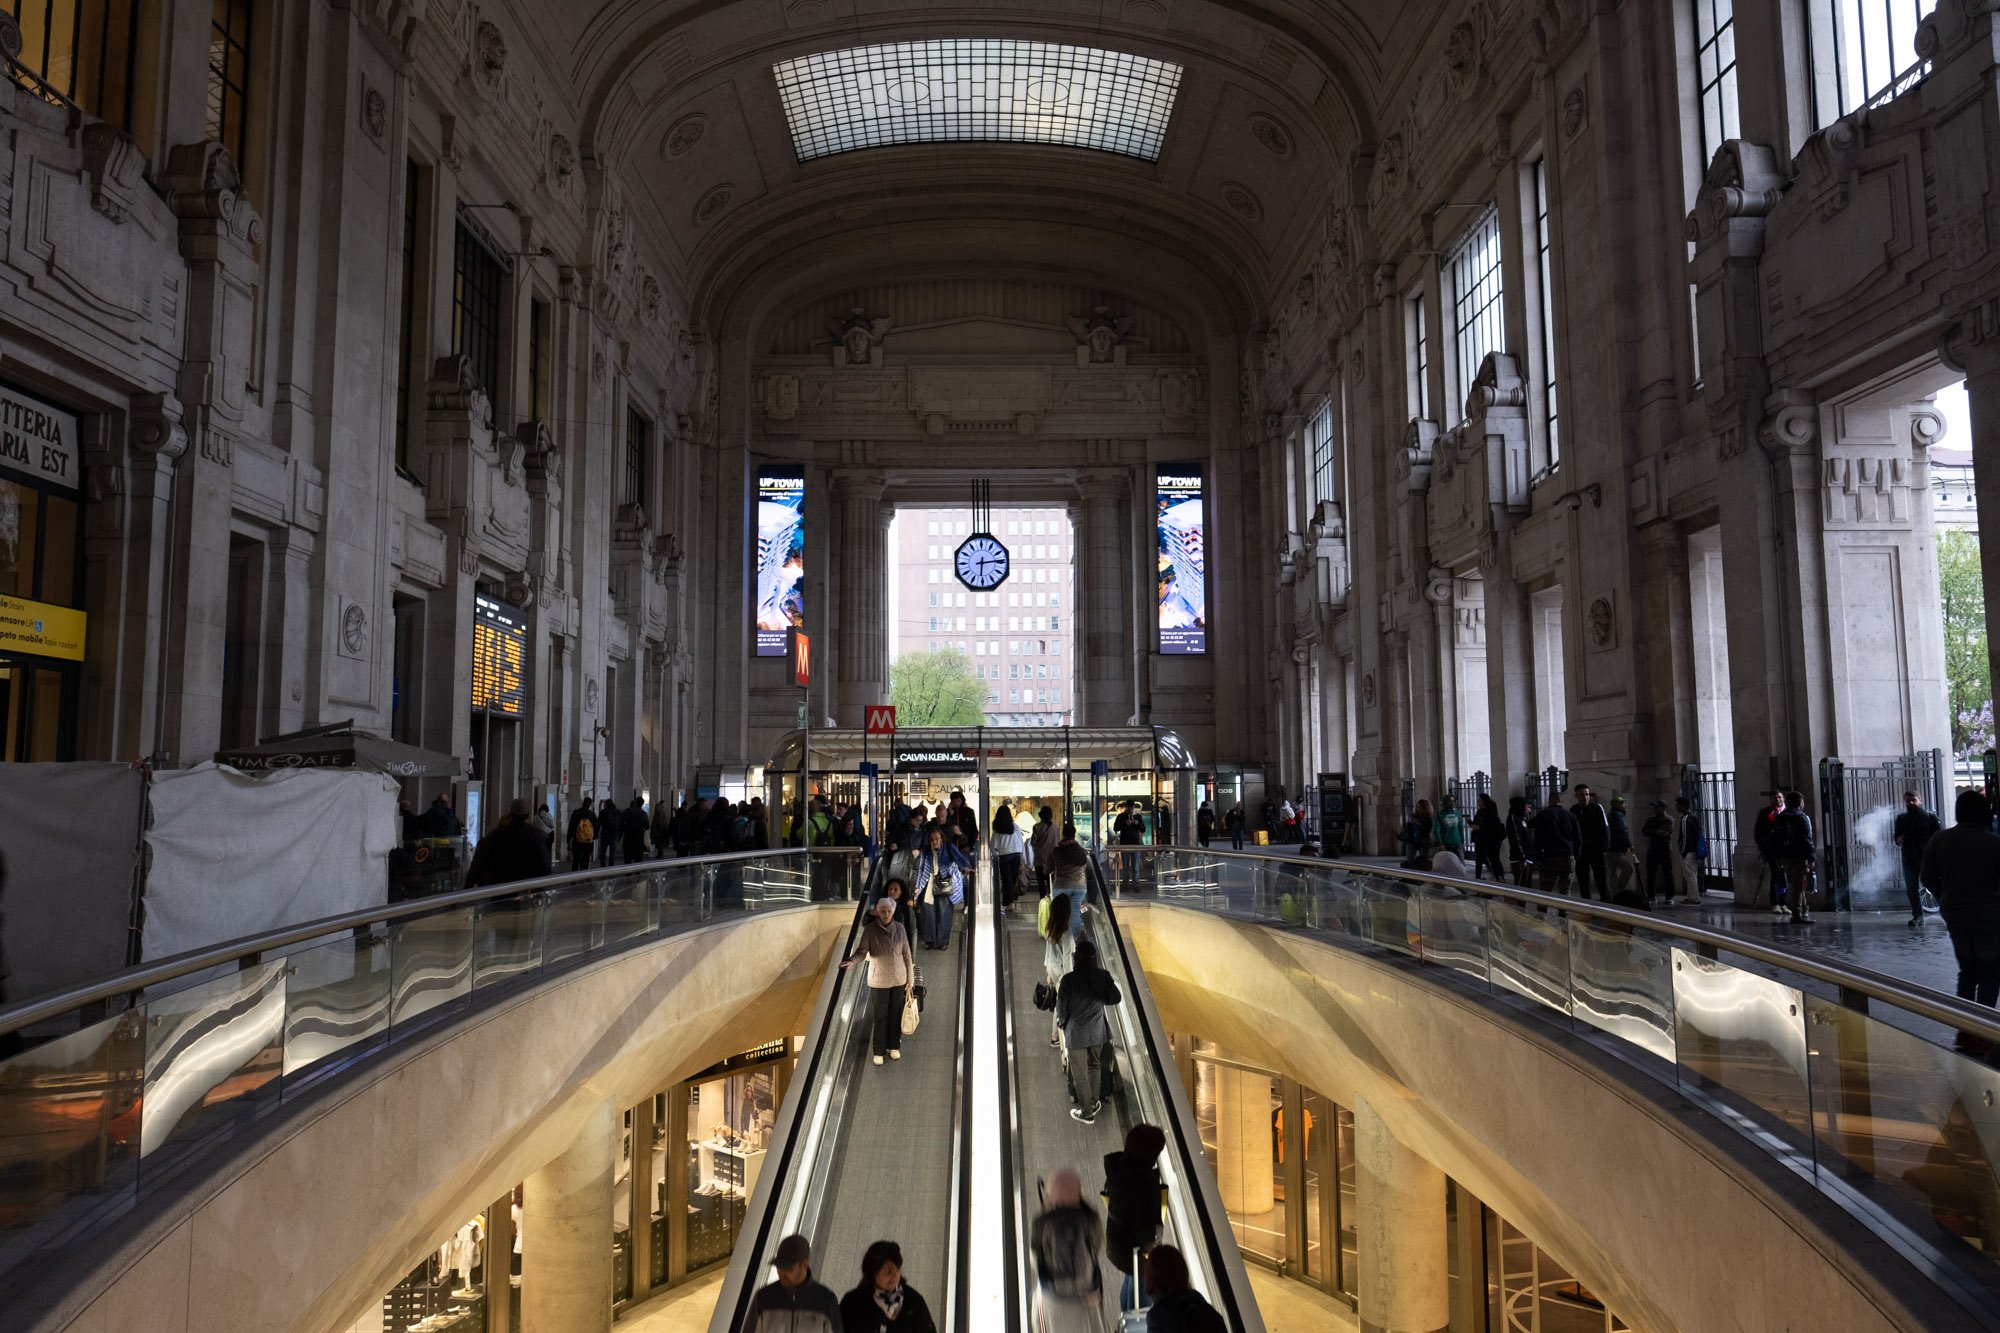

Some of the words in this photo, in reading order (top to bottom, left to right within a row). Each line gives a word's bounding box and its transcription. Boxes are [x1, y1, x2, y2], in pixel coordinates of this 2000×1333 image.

[2, 398, 62, 446] TTERIA
[0, 430, 30, 465] RIA
[41, 445, 69, 477] EST
[759, 477, 804, 488] UPTOWN
[1157, 476, 1202, 487] UPTOWN
[18, 633, 43, 644] mobile
[797, 643, 809, 676] M
[868, 709, 895, 729] M
[900, 753, 927, 761] CALVIN
[929, 753, 949, 761] KLEIN
[950, 753, 975, 761] JEA
[935, 784, 965, 794] CALVN
[745, 1046, 784, 1060] collection
